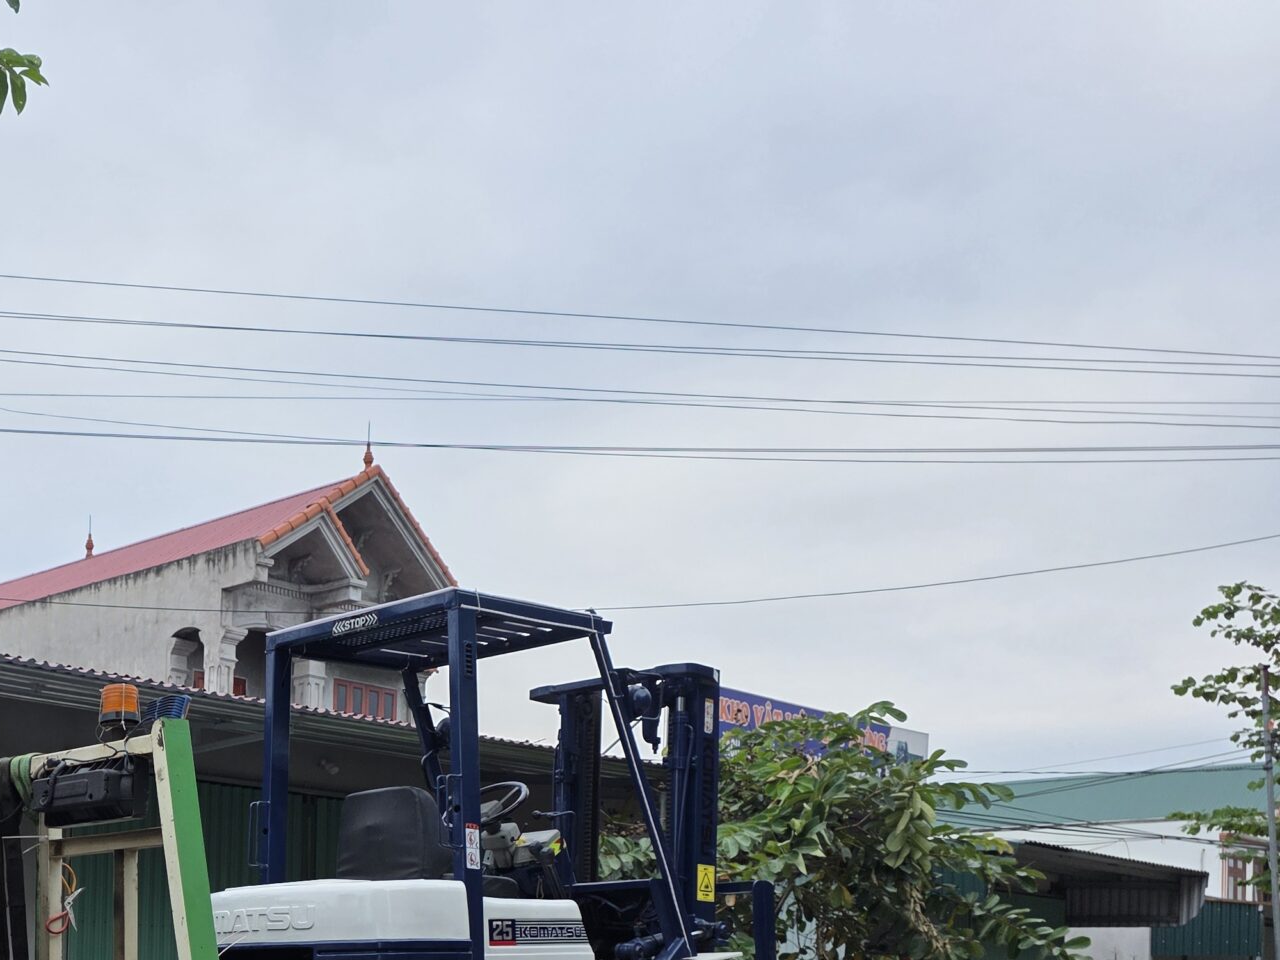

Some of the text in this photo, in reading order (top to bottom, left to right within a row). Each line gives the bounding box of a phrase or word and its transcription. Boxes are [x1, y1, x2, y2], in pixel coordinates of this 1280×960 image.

[344, 617, 366, 631] STOP
[719, 697, 751, 727] KHO
[492, 920, 583, 941] 25 KOMATSU
